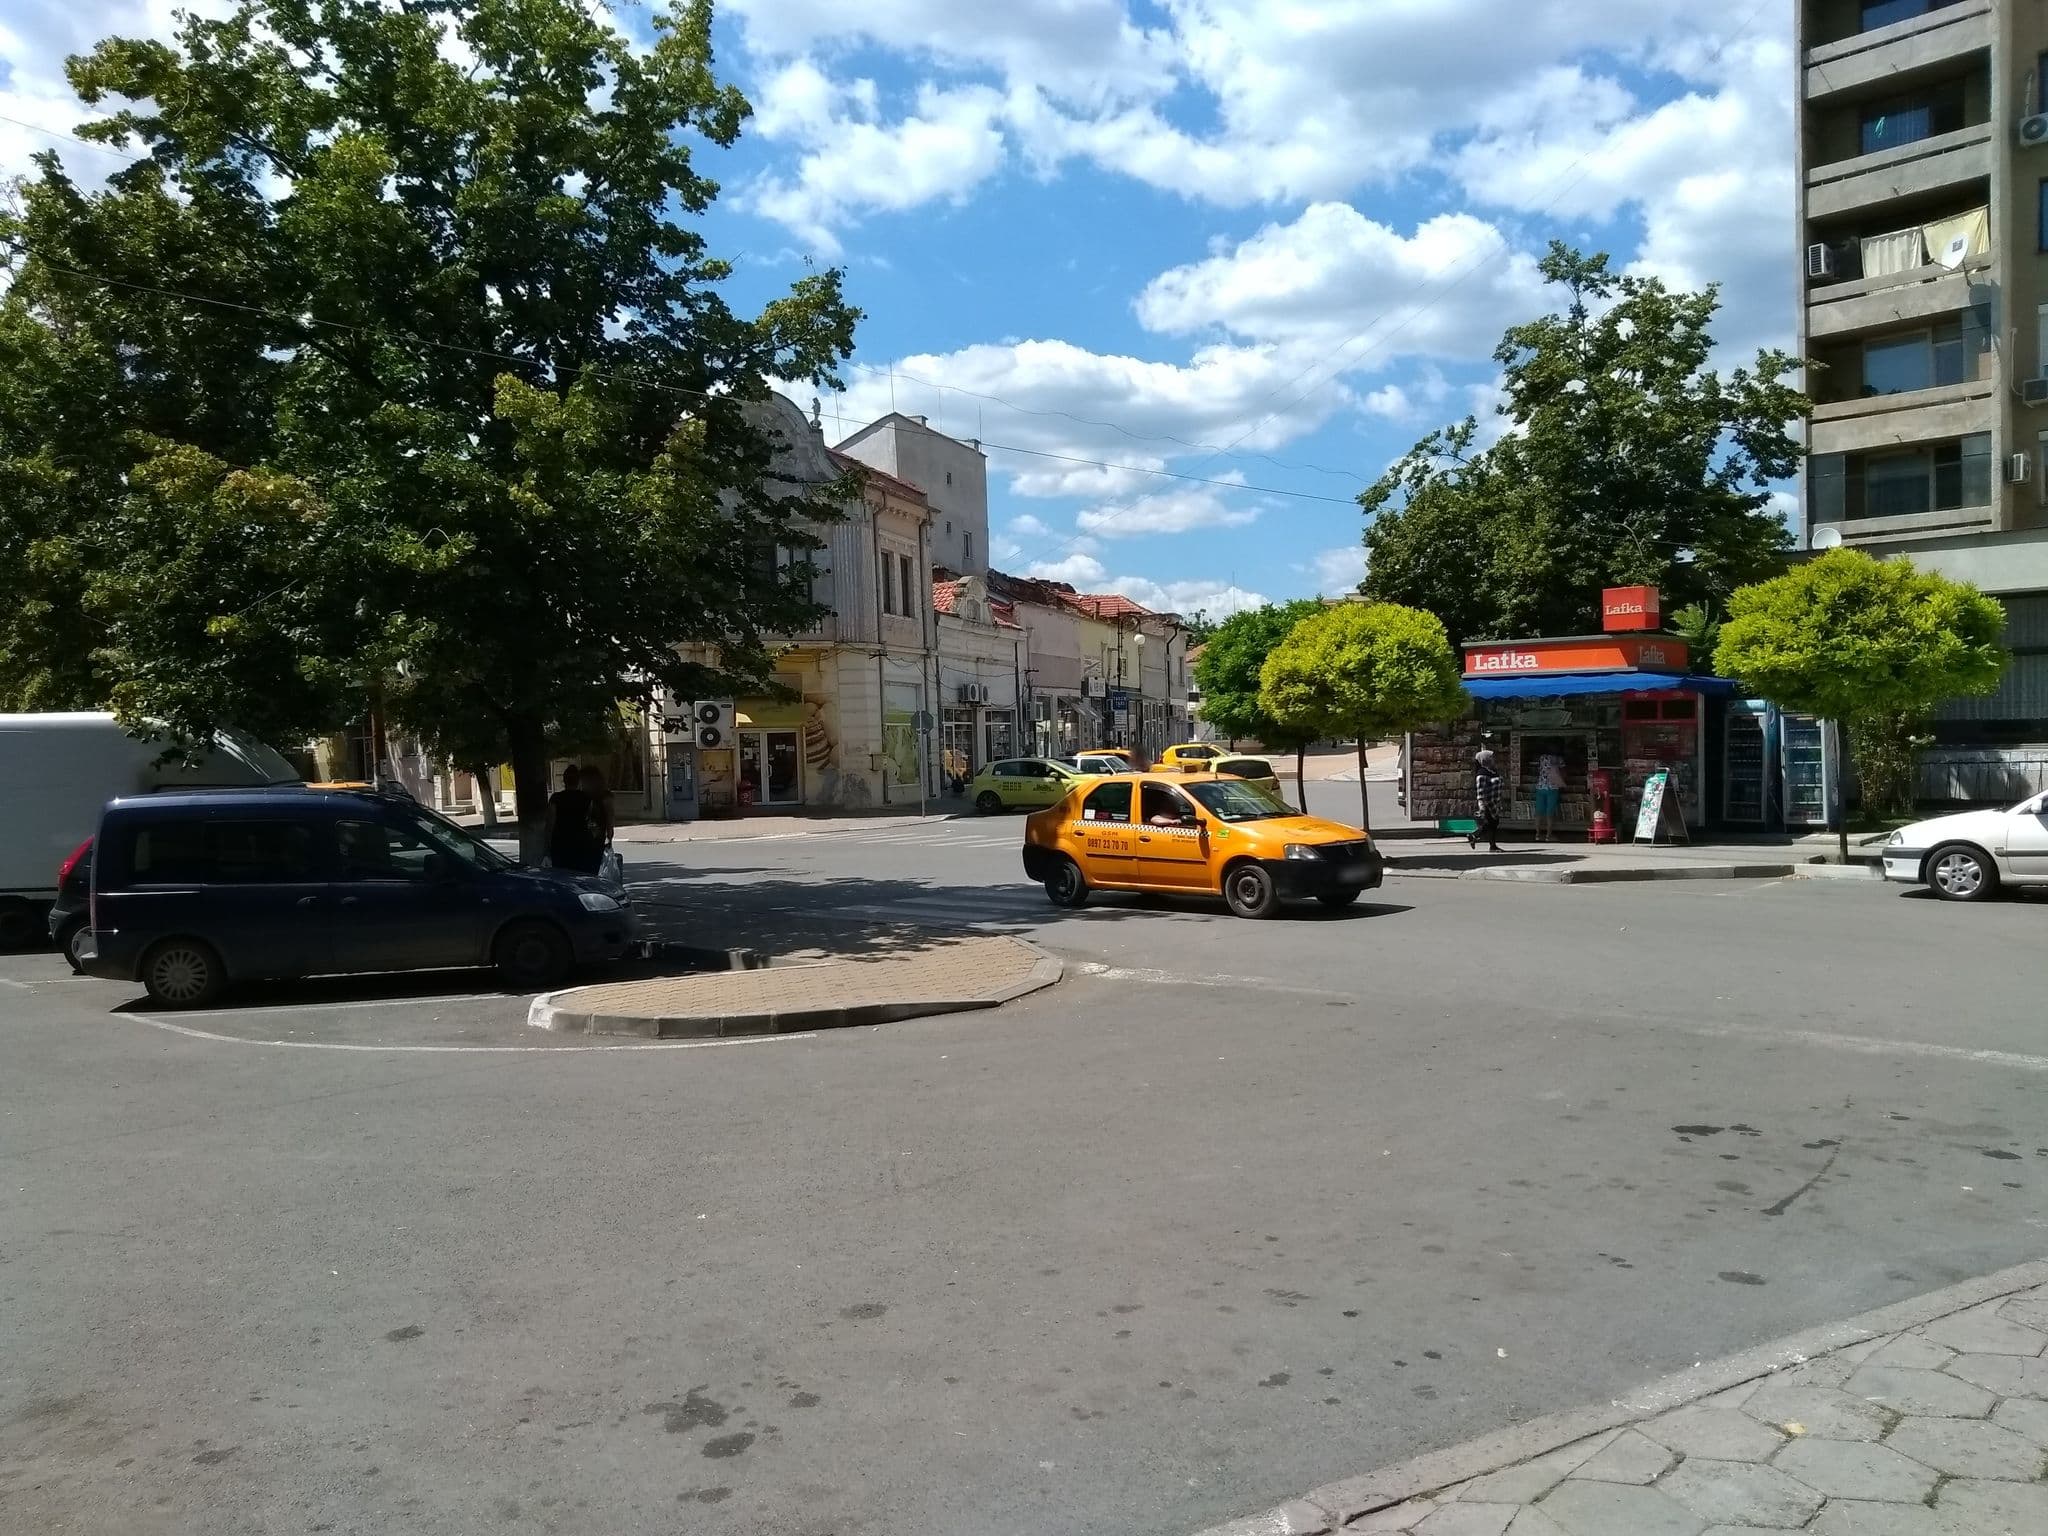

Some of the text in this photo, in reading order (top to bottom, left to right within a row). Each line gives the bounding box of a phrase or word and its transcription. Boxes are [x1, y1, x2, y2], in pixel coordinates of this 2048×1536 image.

[1605, 603, 1642, 615] Lafka
[1474, 650, 1538, 670] Lafka
[1639, 646, 1666, 665] Lafka
[1087, 838, 1129, 851] 0897 23 70 70
